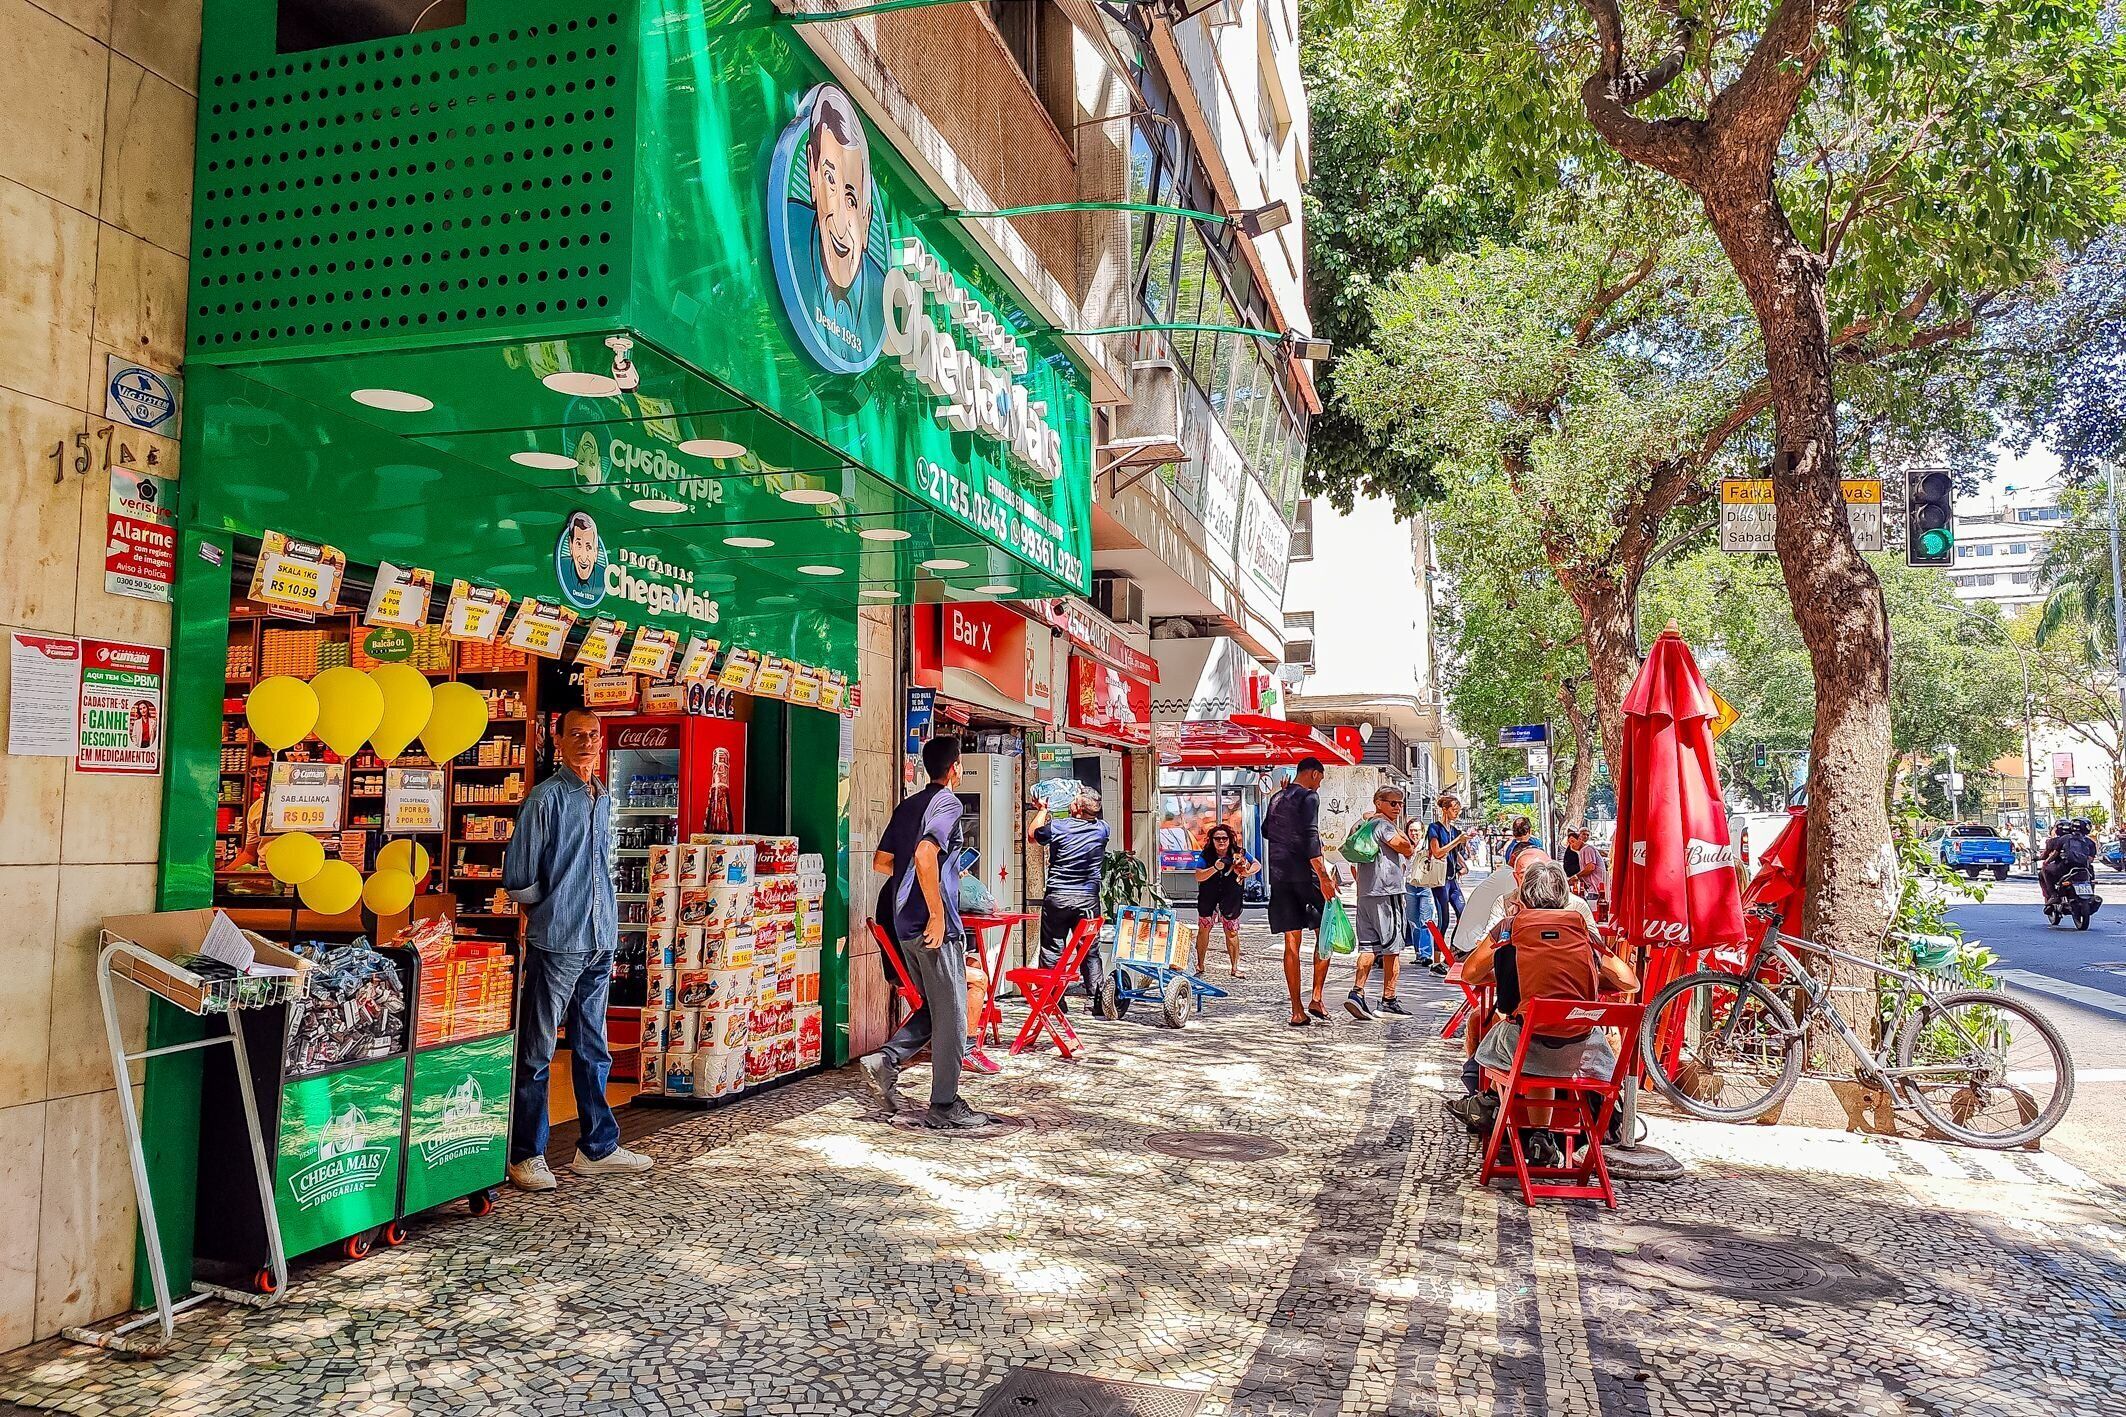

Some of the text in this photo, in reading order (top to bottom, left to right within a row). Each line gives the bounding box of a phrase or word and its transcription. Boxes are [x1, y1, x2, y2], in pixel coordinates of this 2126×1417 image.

[815, 306, 862, 353] Desde 1933
[138, 393, 169, 409] SYSTEM
[119, 497, 173, 518] verisure
[1727, 511, 1755, 522] Dias
[1853, 511, 1876, 522] 21h
[112, 520, 174, 549] Alarme
[134, 545, 172, 559] com registro
[133, 554, 172, 568] de imagens
[619, 548, 694, 584] DROGARIAS
[116, 562, 137, 573] Aviso
[143, 567, 167, 579] Polícia
[278, 564, 318, 580] SKALA 1KG
[116, 577, 134, 586] 0300
[134, 579, 143, 588] 50
[143, 581, 152, 590] 50
[153, 583, 165, 592] 500
[287, 583, 317, 599] 10,99
[572, 589, 584, 598] Desde
[388, 598, 400, 606] POR
[536, 630, 550, 638] POR
[953, 609, 992, 654] Bar X
[372, 638, 405, 649] Balcão 01
[534, 638, 549, 647] 9,99
[86, 672, 158, 688] AQUI TEM PBM
[606, 690, 627, 698] 32,99
[83, 695, 129, 710] CADASTRE-SE
[657, 701, 678, 709] 12,99
[82, 710, 129, 731] E GANHE
[81, 731, 128, 748] DESCONTO
[80, 750, 156, 764] EM MEDICAMENTOS
[301, 811, 325, 824] 0,99
[404, 806, 417, 814] POR
[401, 817, 414, 825] POR
[417, 817, 433, 825] 13,99
[439, 1145, 480, 1166] DROGARIAS
[300, 1154, 381, 1191] CHEGA MAIS
[314, 1182, 365, 1206] DROGARIAS
